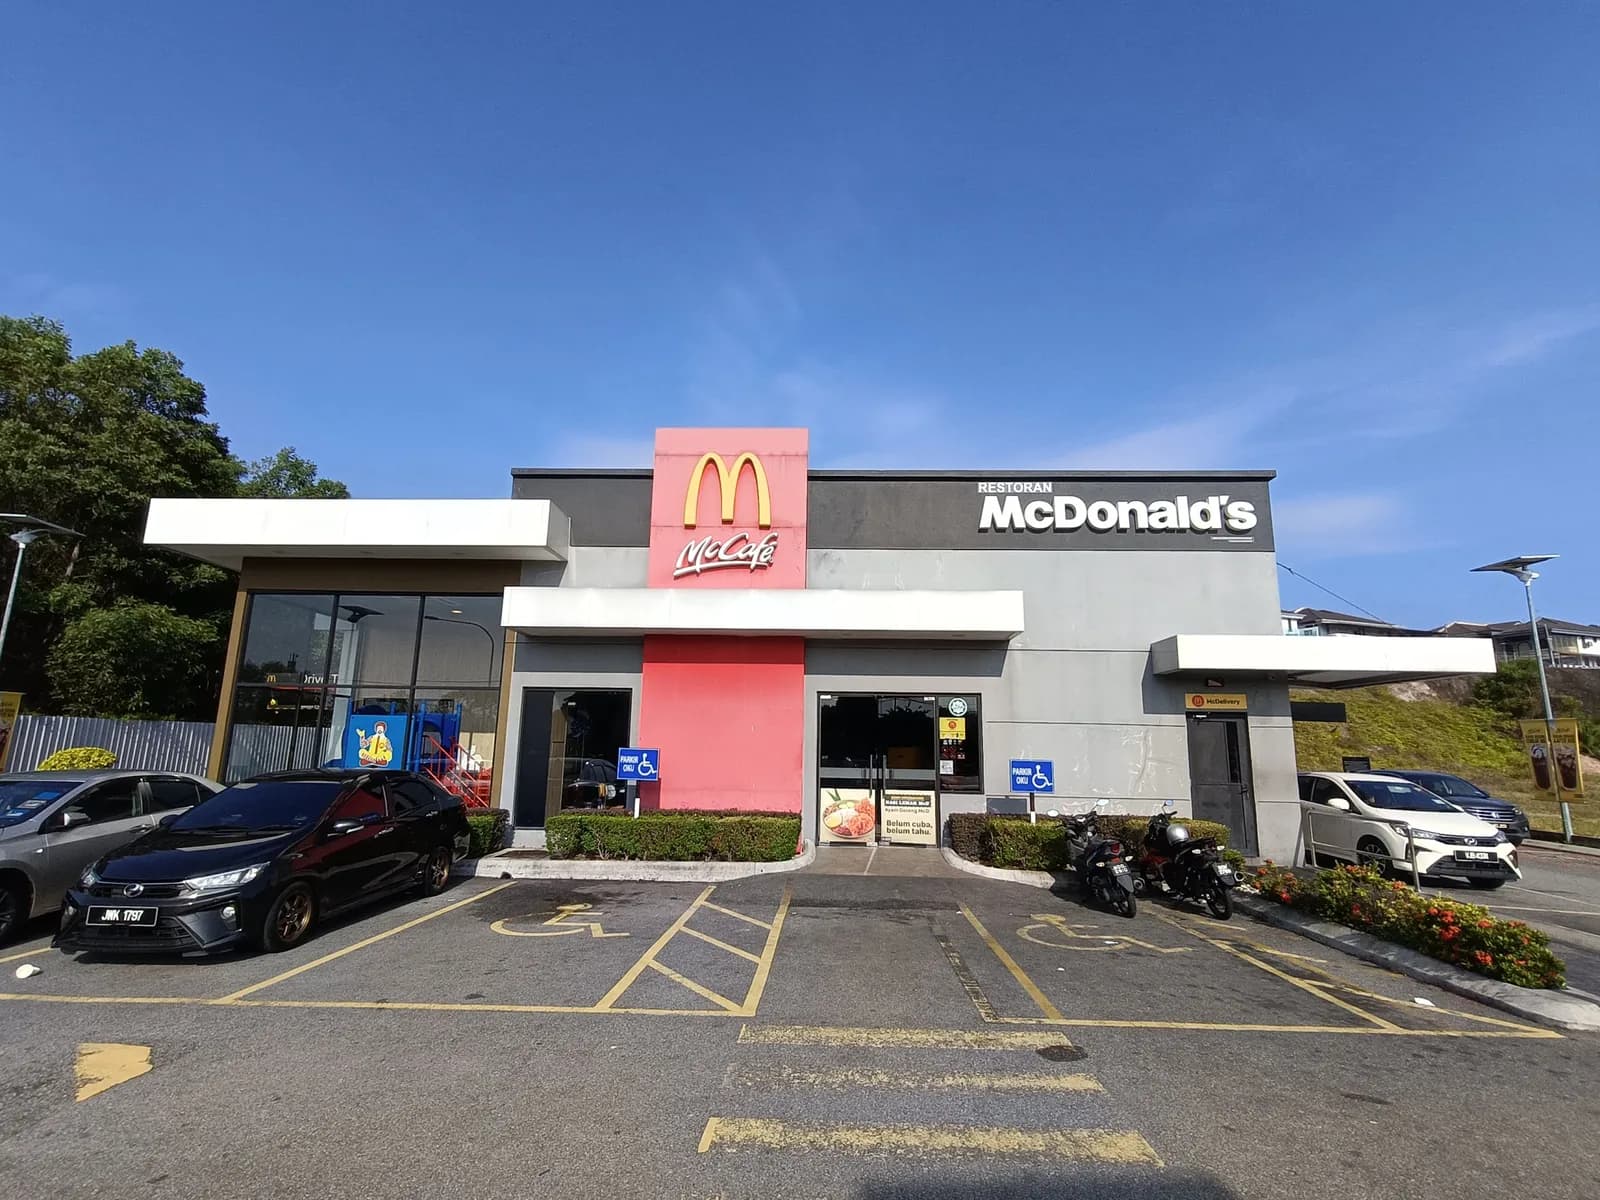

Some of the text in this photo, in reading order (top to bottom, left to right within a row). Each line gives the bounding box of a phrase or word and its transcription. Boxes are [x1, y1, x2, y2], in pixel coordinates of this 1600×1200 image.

[977, 482, 1052, 493] RESTORAN
[978, 495, 1258, 533] McDonald's
[673, 532, 779, 579] McCafé
[912, 821, 933, 829] cuba,
